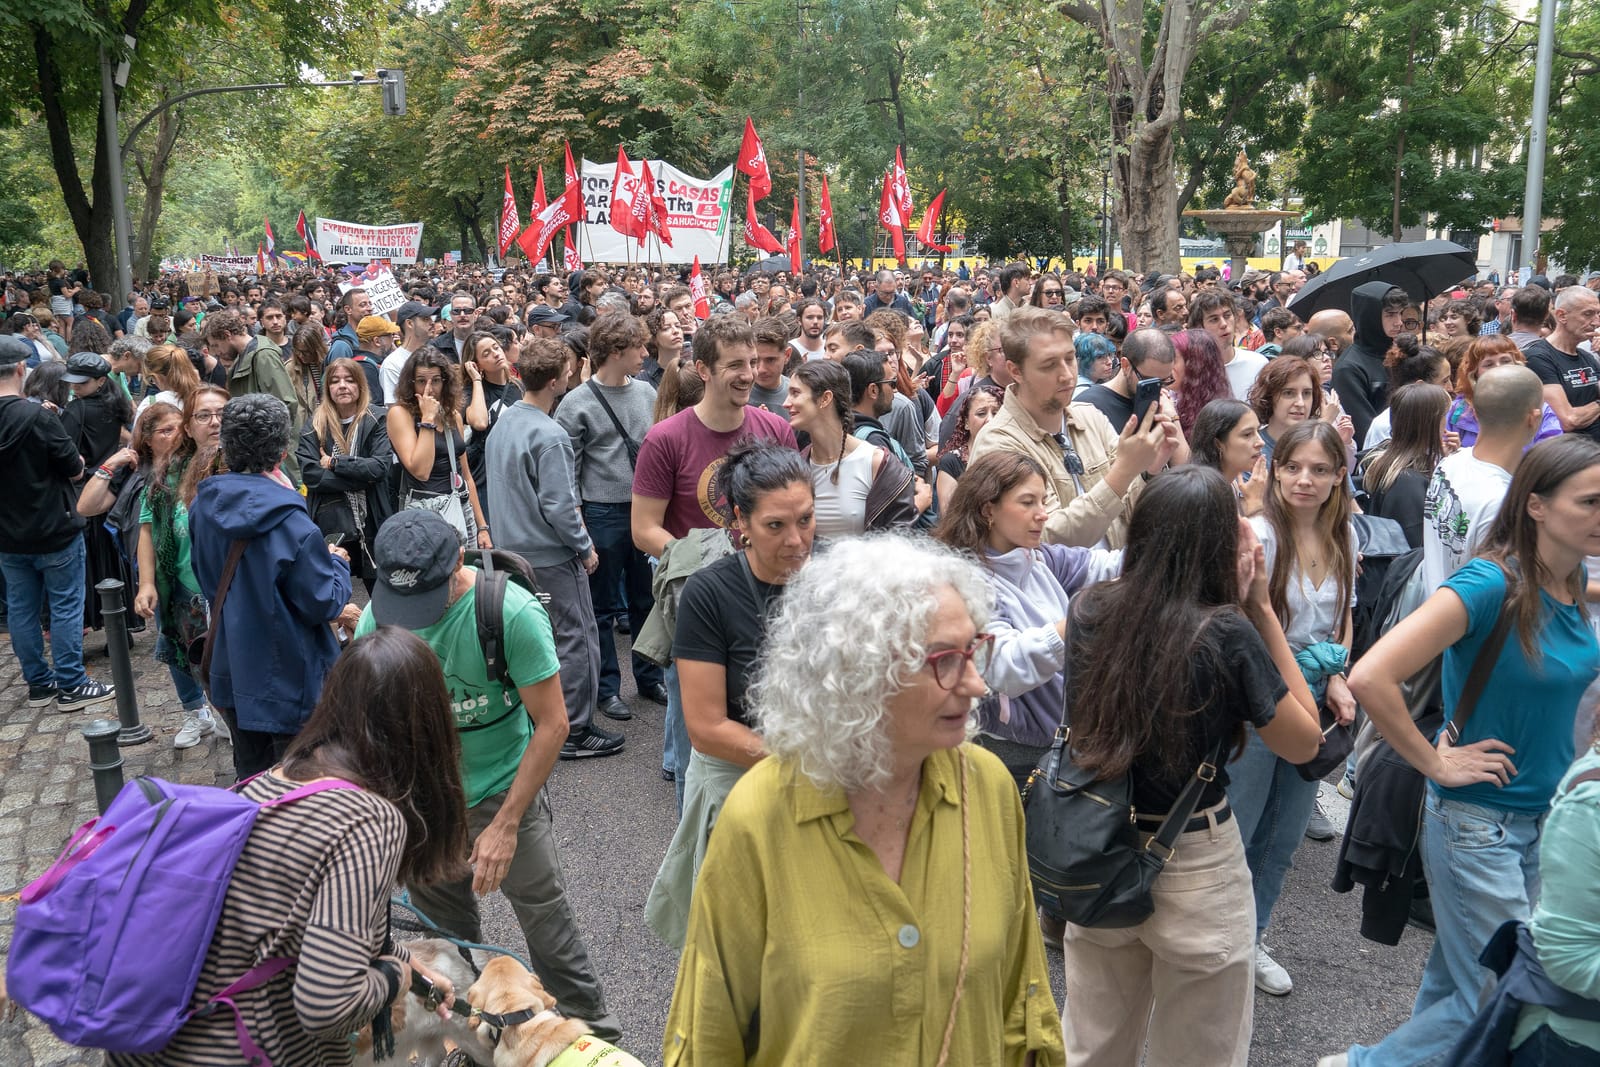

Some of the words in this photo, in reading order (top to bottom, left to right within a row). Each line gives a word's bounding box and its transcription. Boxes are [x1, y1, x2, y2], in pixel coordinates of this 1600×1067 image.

[582, 176, 612, 193] TOD
[669, 180, 719, 202] CASAS
[582, 193, 611, 209] AR
[322, 222, 363, 235] EXPROPIAR
[377, 226, 419, 236] RENTISTAS
[347, 234, 412, 247] CAPITALISTAS
